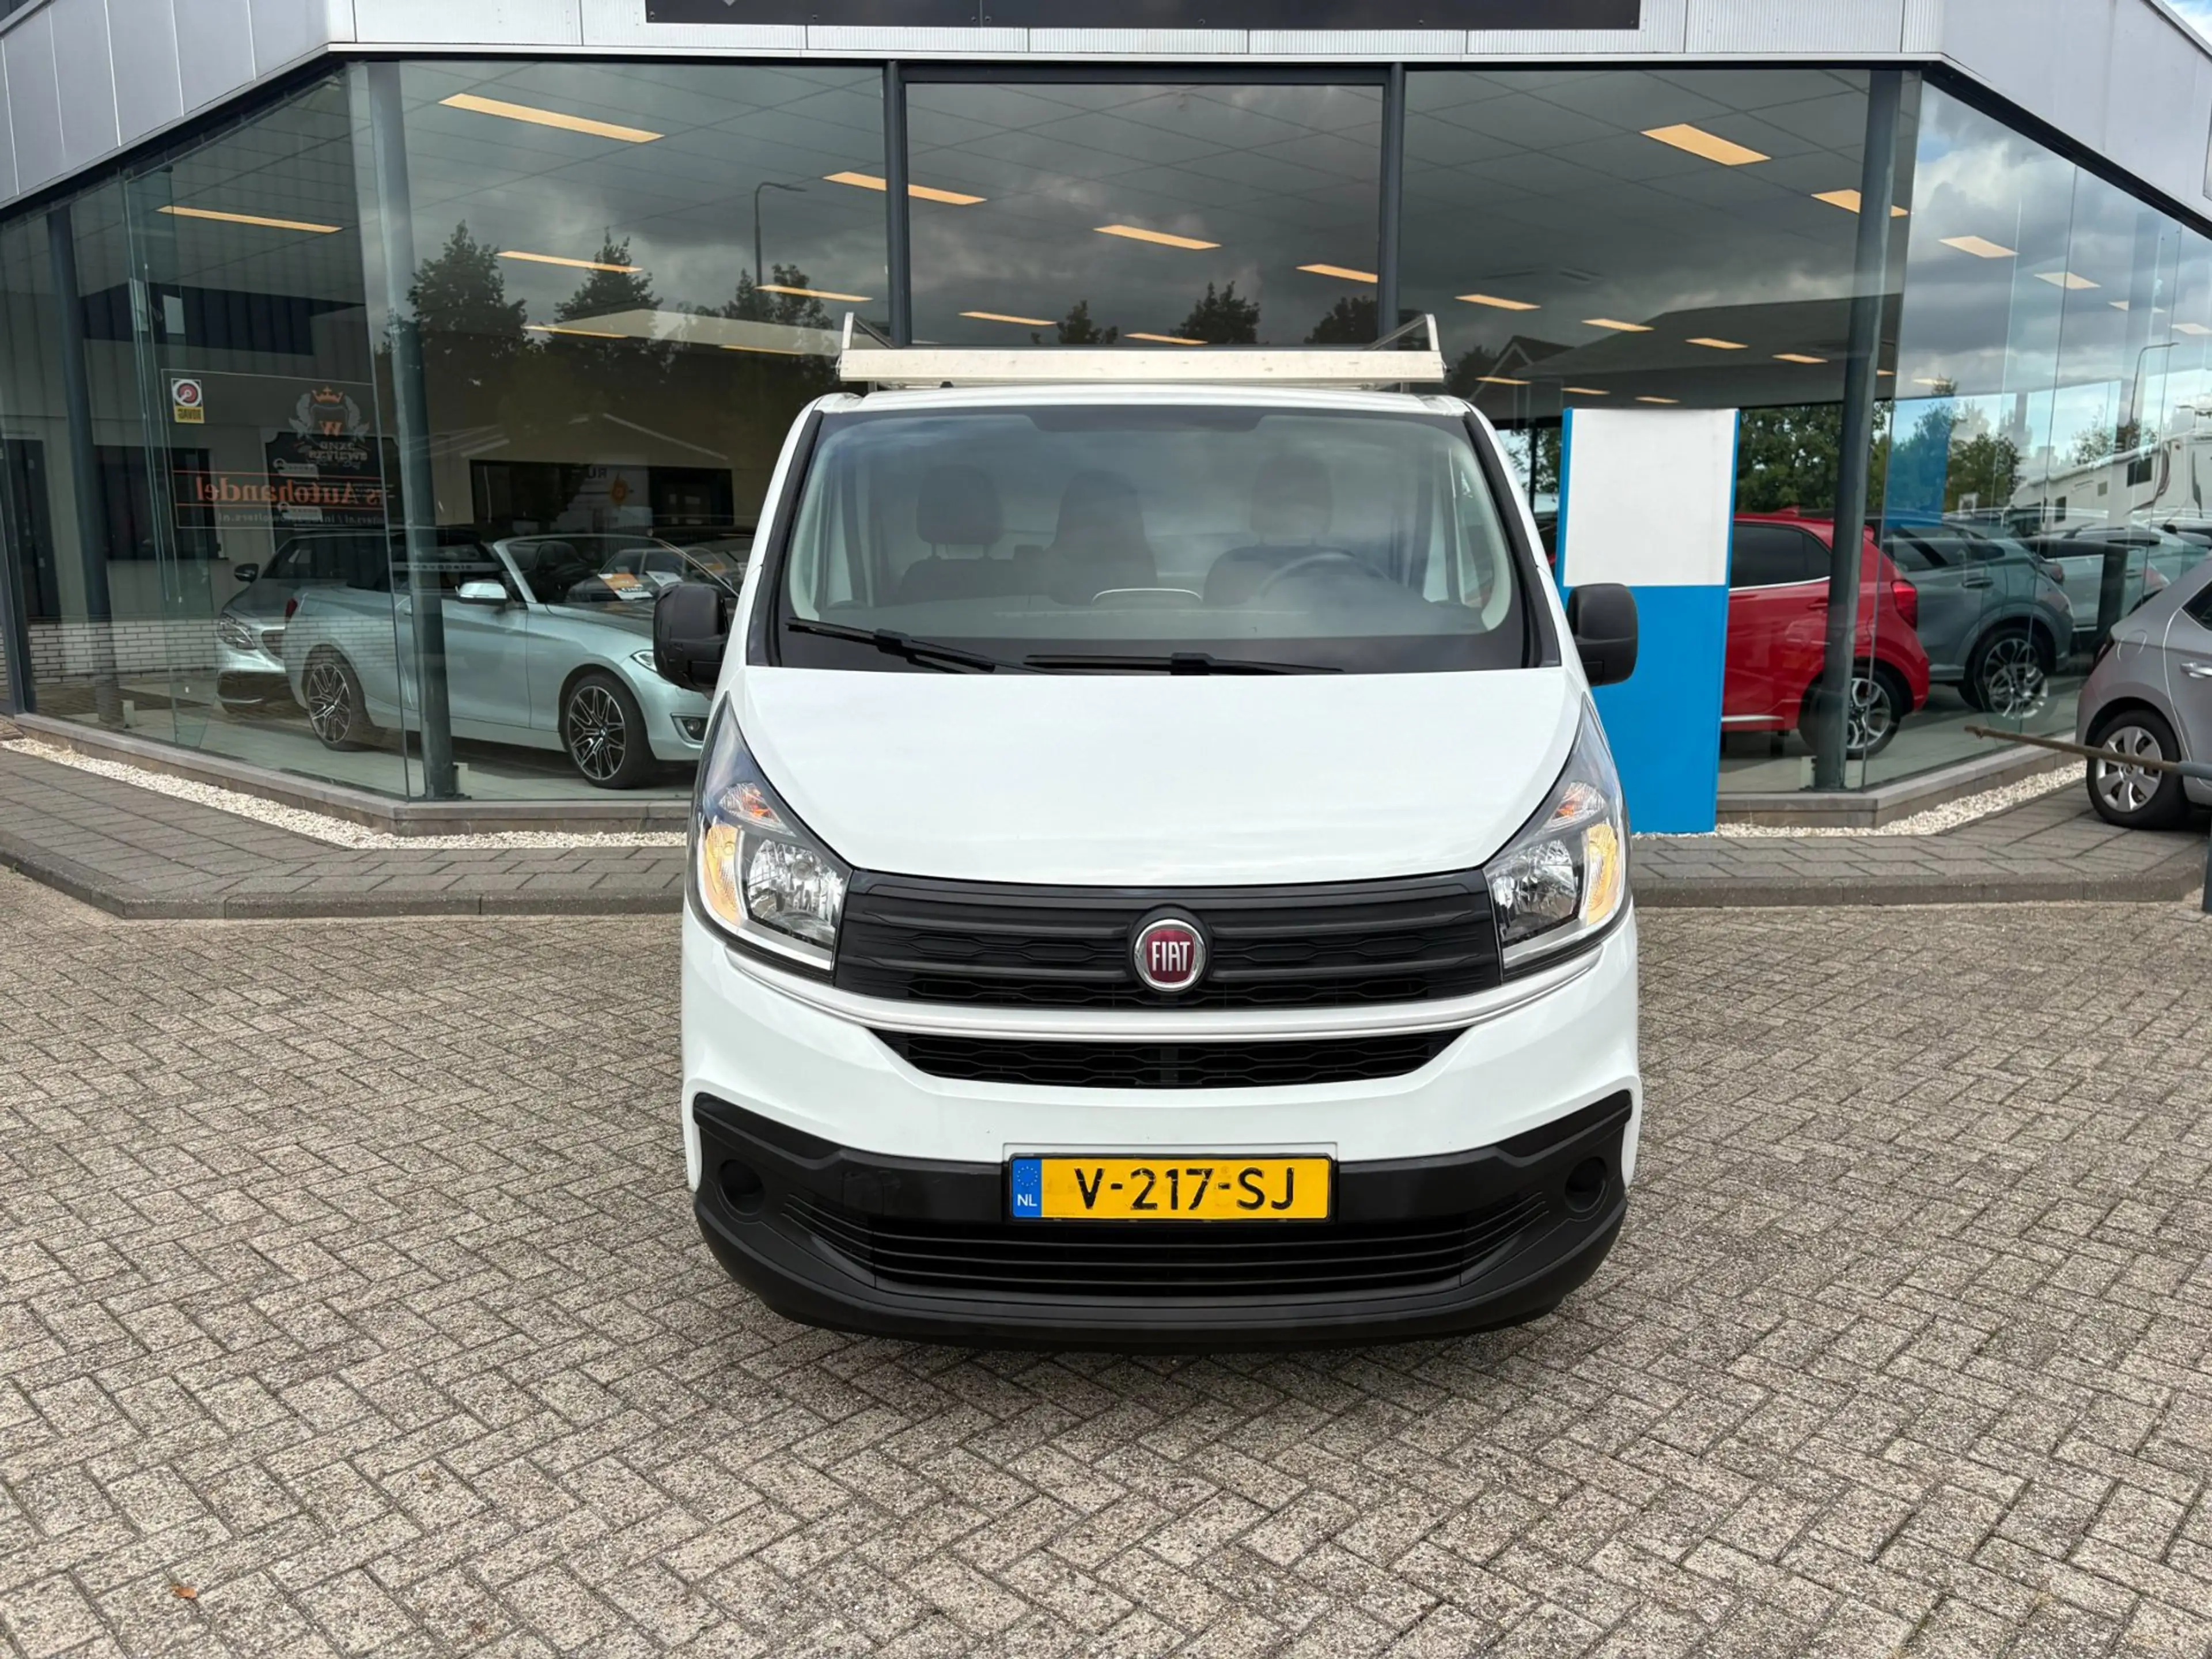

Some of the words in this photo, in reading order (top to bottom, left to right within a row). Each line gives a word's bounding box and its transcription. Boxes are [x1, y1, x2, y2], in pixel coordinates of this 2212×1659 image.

[1152, 941, 1191, 972] FIAT
[1017, 1194, 1037, 1206] NL
[1074, 1166, 1294, 1210] V-217-SJ
